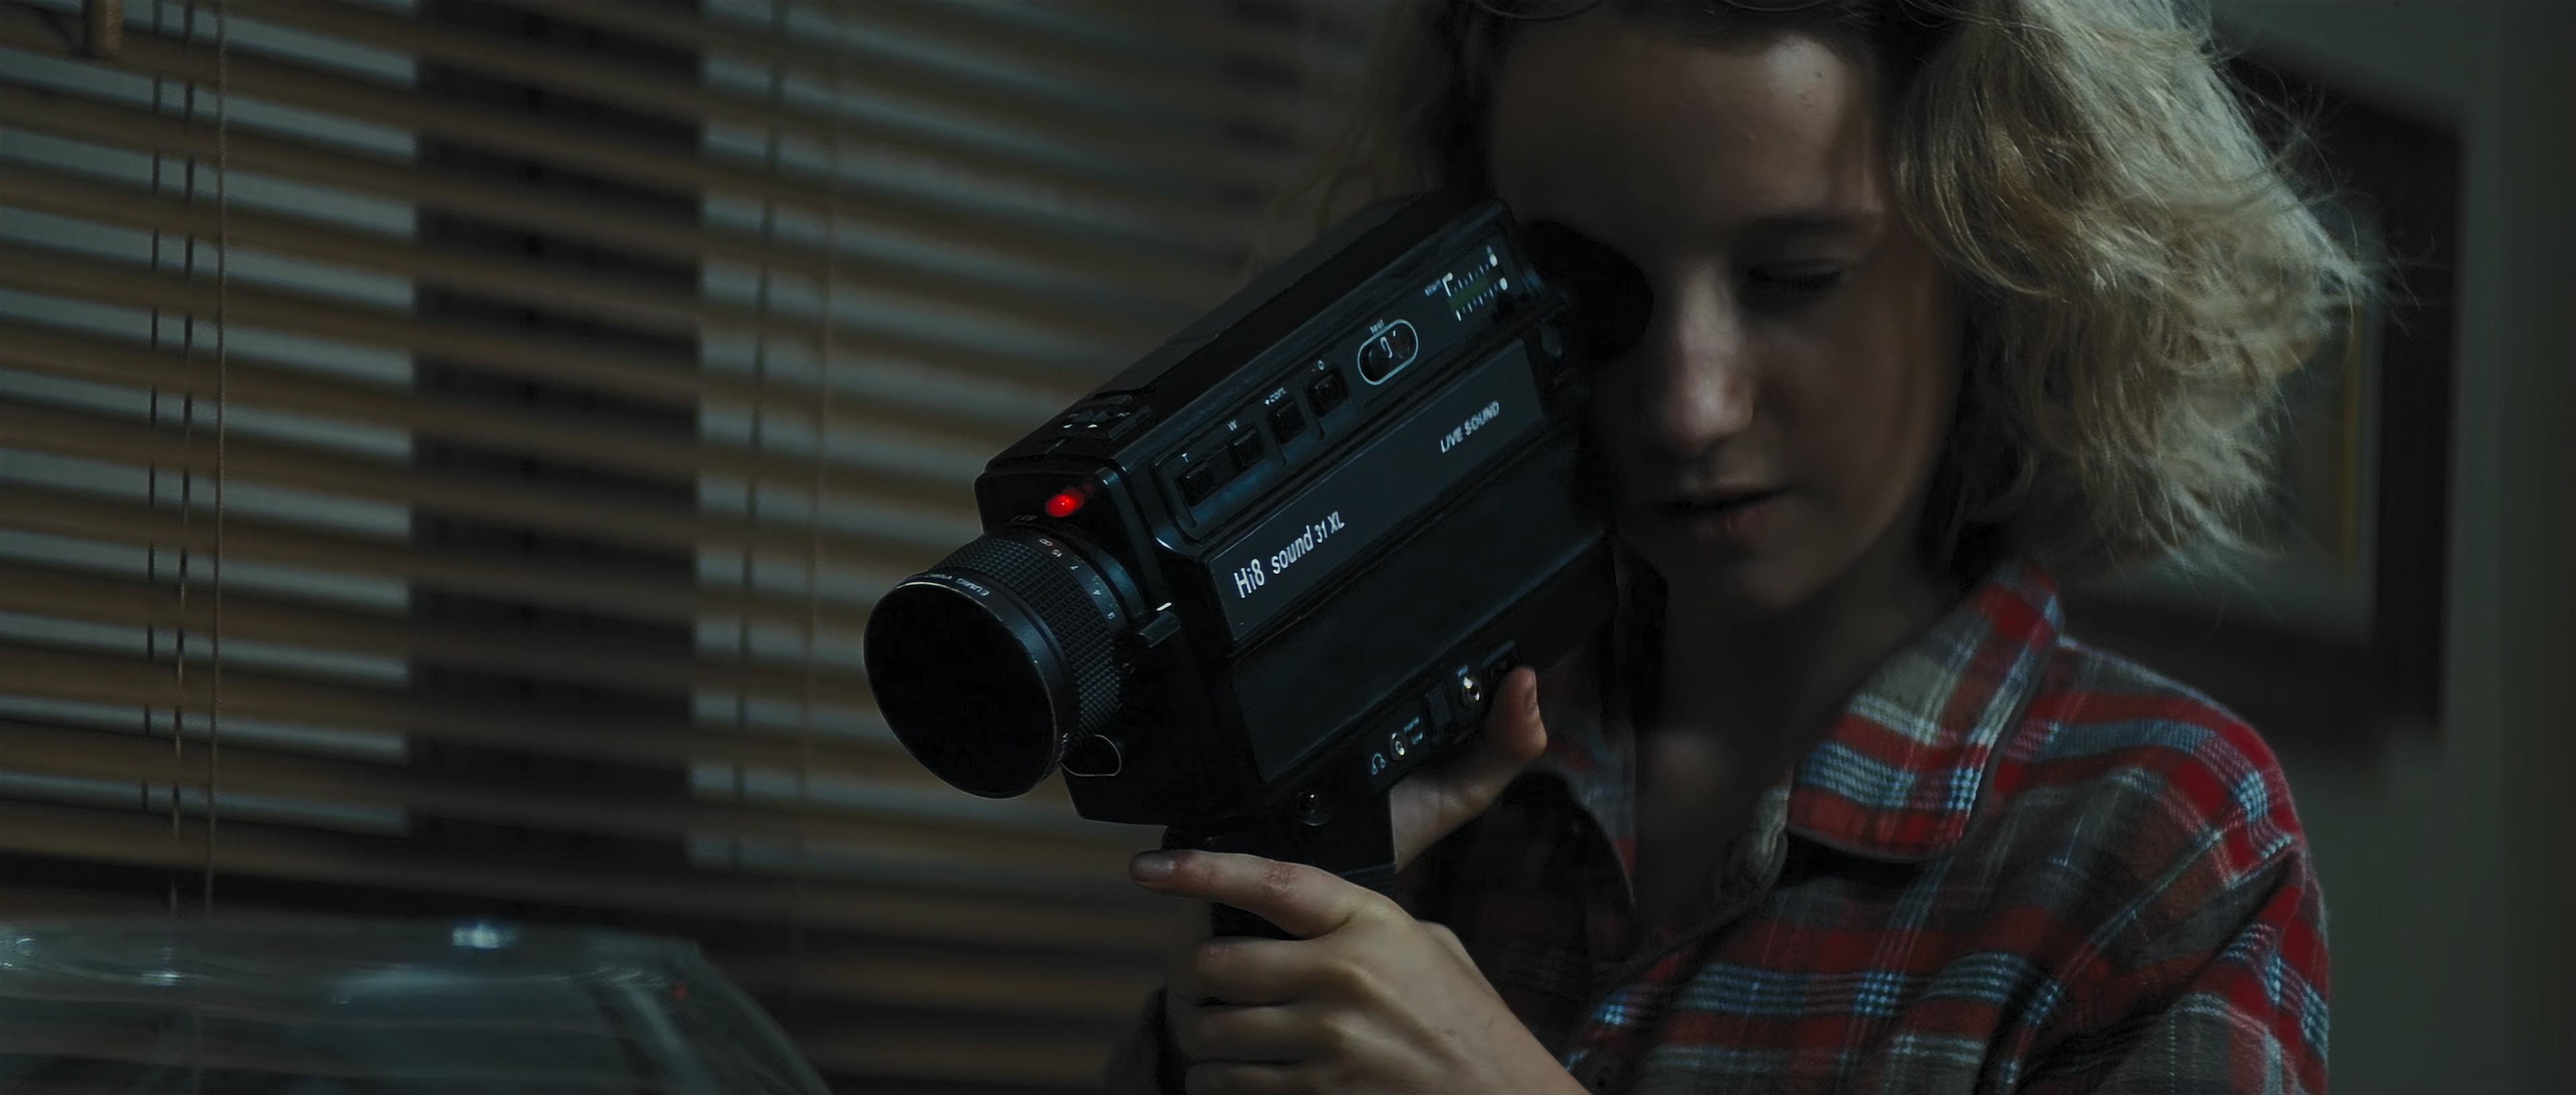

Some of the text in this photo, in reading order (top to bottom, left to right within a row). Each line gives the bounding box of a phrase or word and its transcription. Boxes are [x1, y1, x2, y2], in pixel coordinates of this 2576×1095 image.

[1440, 399, 1499, 454] LIVE SOUND
[1181, 452, 1189, 463] T
[1234, 511, 1345, 598] Hi8 sound 31 XL
